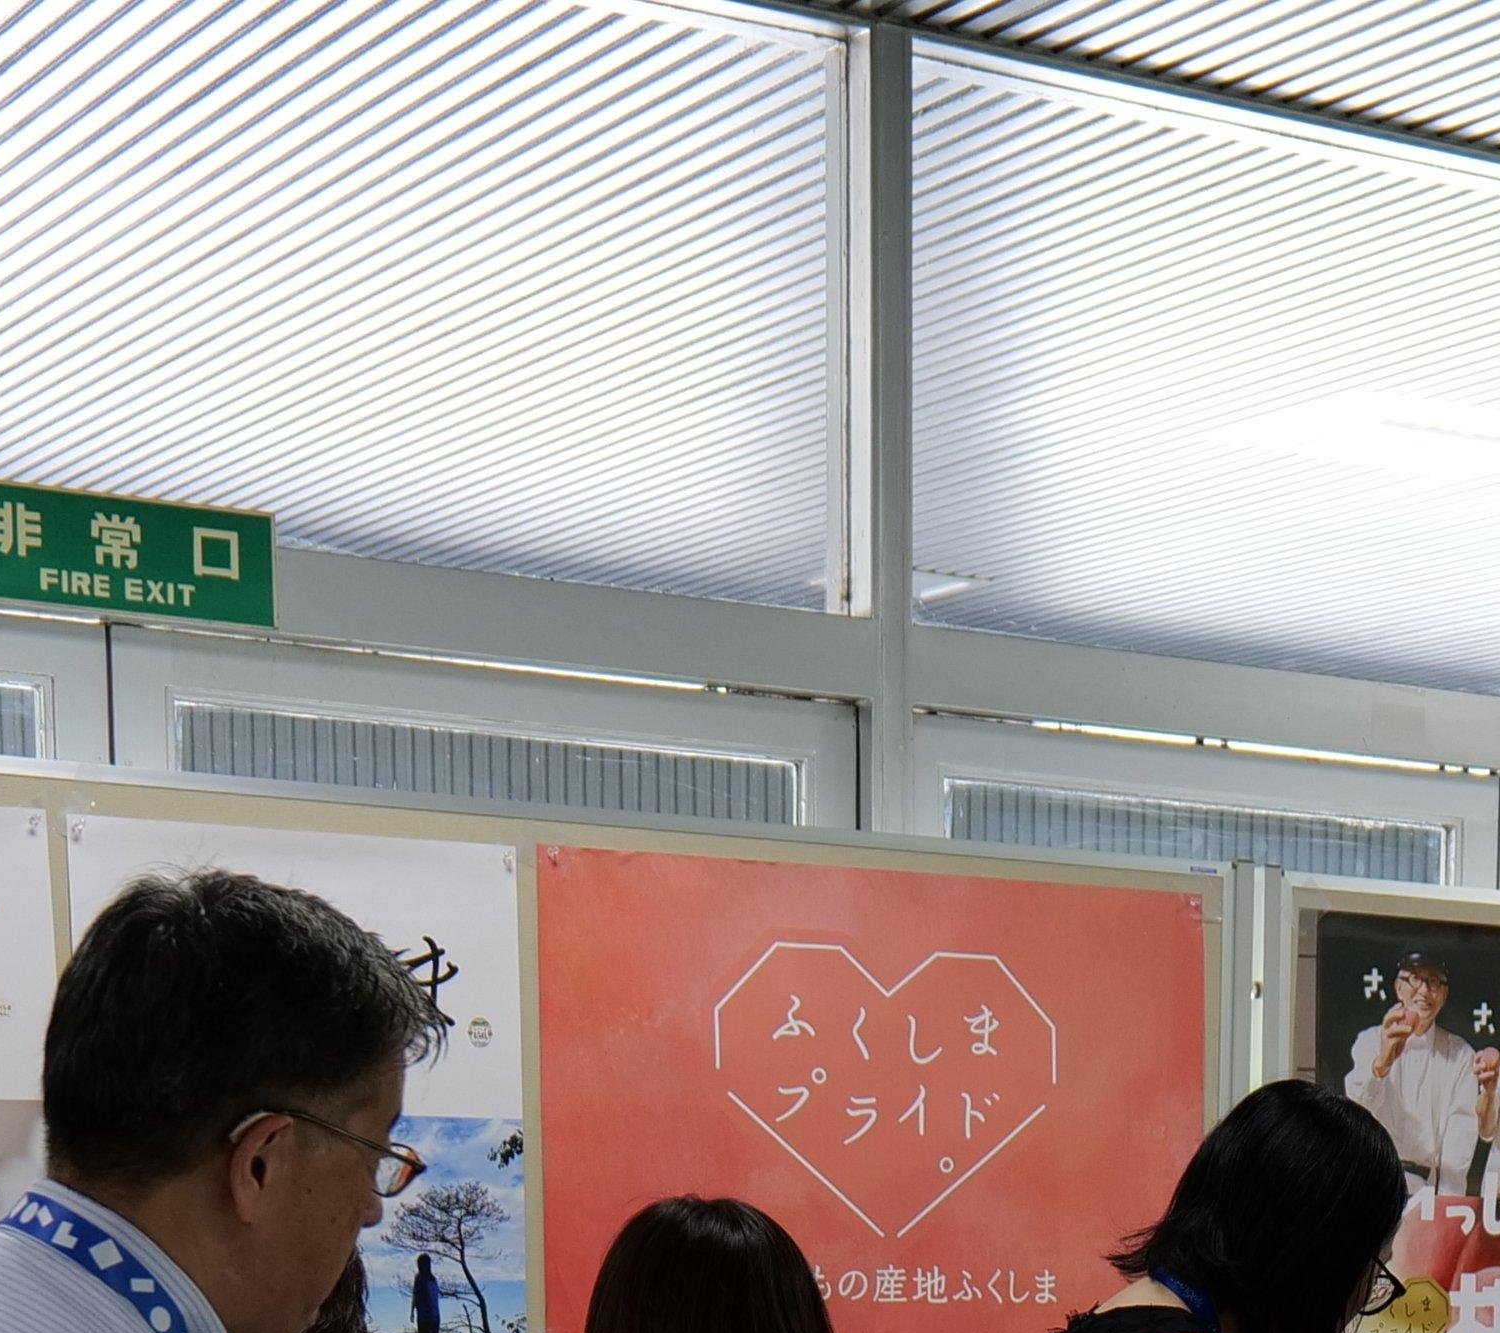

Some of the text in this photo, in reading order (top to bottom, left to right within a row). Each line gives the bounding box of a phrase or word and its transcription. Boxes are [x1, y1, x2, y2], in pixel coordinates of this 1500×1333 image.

[39, 567, 196, 607] FIRE EXIT
[773, 994, 999, 1064] ふくしま
